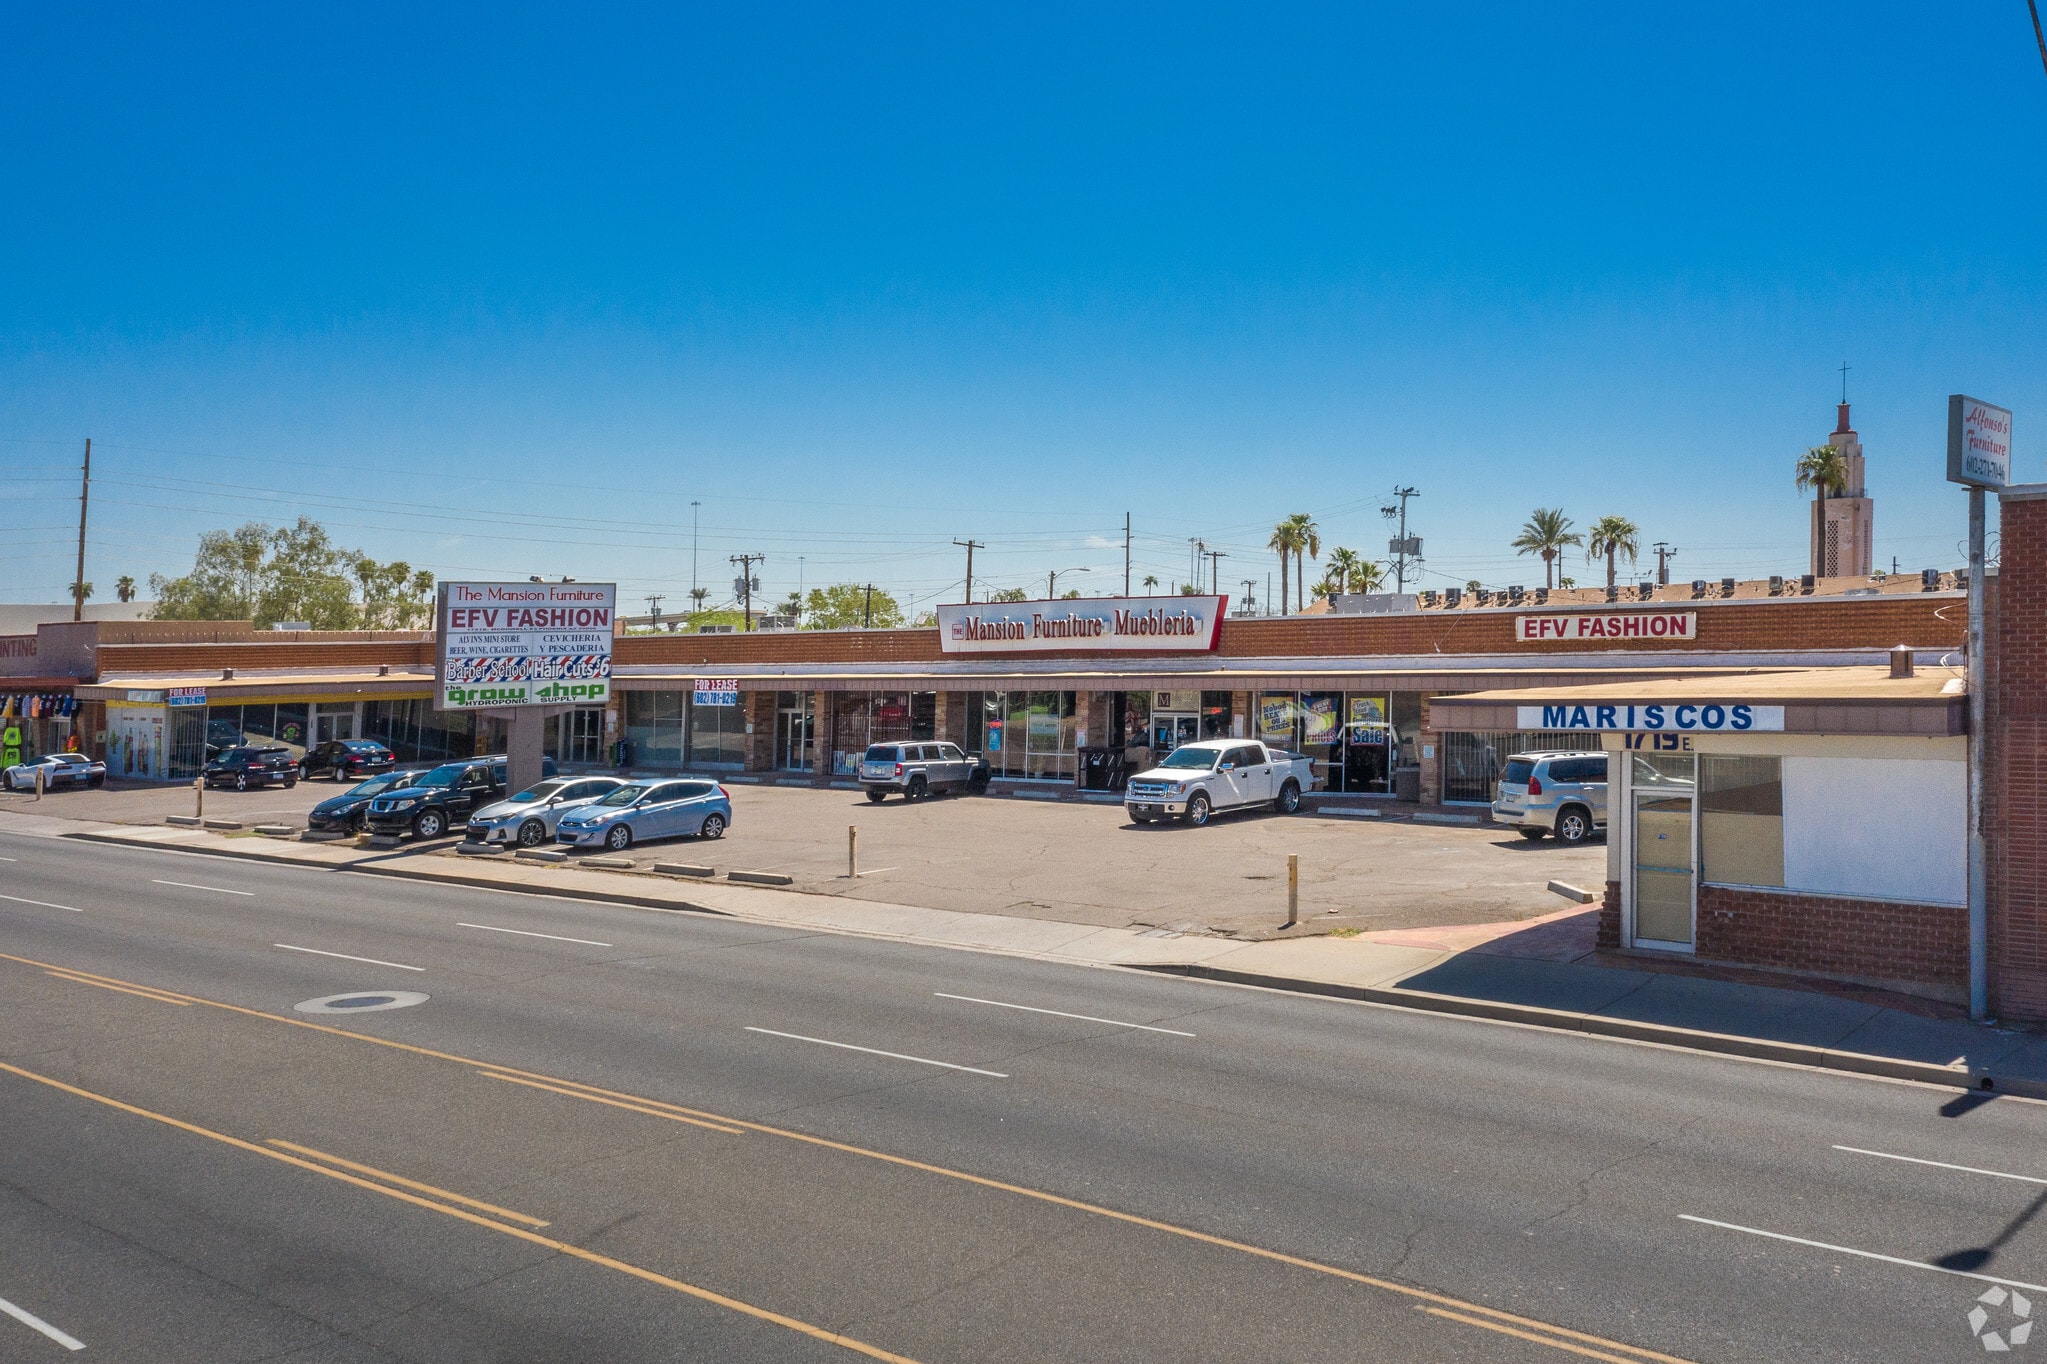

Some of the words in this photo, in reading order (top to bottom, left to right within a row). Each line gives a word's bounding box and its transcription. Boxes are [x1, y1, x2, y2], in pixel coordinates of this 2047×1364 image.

[1966, 407, 2008, 434] Alfonso's
[1966, 429, 2007, 456] Furniture
[456, 586, 482, 601] The
[488, 587, 545, 601] Mansion
[550, 587, 604, 601] Furniture
[451, 609, 499, 628] EFV
[507, 608, 608, 627] FASHION
[966, 616, 1025, 640] Mansion
[1033, 613, 1102, 638] Furniture
[1114, 608, 1195, 636] Muebleria
[1524, 618, 1569, 638] EFV
[1578, 615, 1687, 637] FASHION
[484, 635, 499, 643] MINI
[500, 635, 520, 643] STORE
[543, 634, 601, 642] CEVICHERIA
[449, 647, 467, 655] BEER,
[469, 646, 488, 655] WINE,
[489, 646, 529, 654] CIGARETTES
[539, 645, 546, 653] Y
[446, 661, 488, 680] Barber
[490, 660, 530, 678] School
[533, 660, 561, 678] Hair
[563, 660, 594, 677] Cuts
[169, 688, 183, 696] FOR
[184, 687, 206, 695] LEASE
[695, 679, 709, 690] FOR
[711, 679, 738, 690] LEASE
[448, 688, 525, 705] grow
[534, 682, 605, 699] shop
[1159, 695, 1169, 706] M
[465, 698, 529, 706] HYDROPONIC
[1543, 705, 1752, 730] MARISCOS
[1353, 726, 1382, 743] Sale
[1683, 737, 1694, 751] E.
